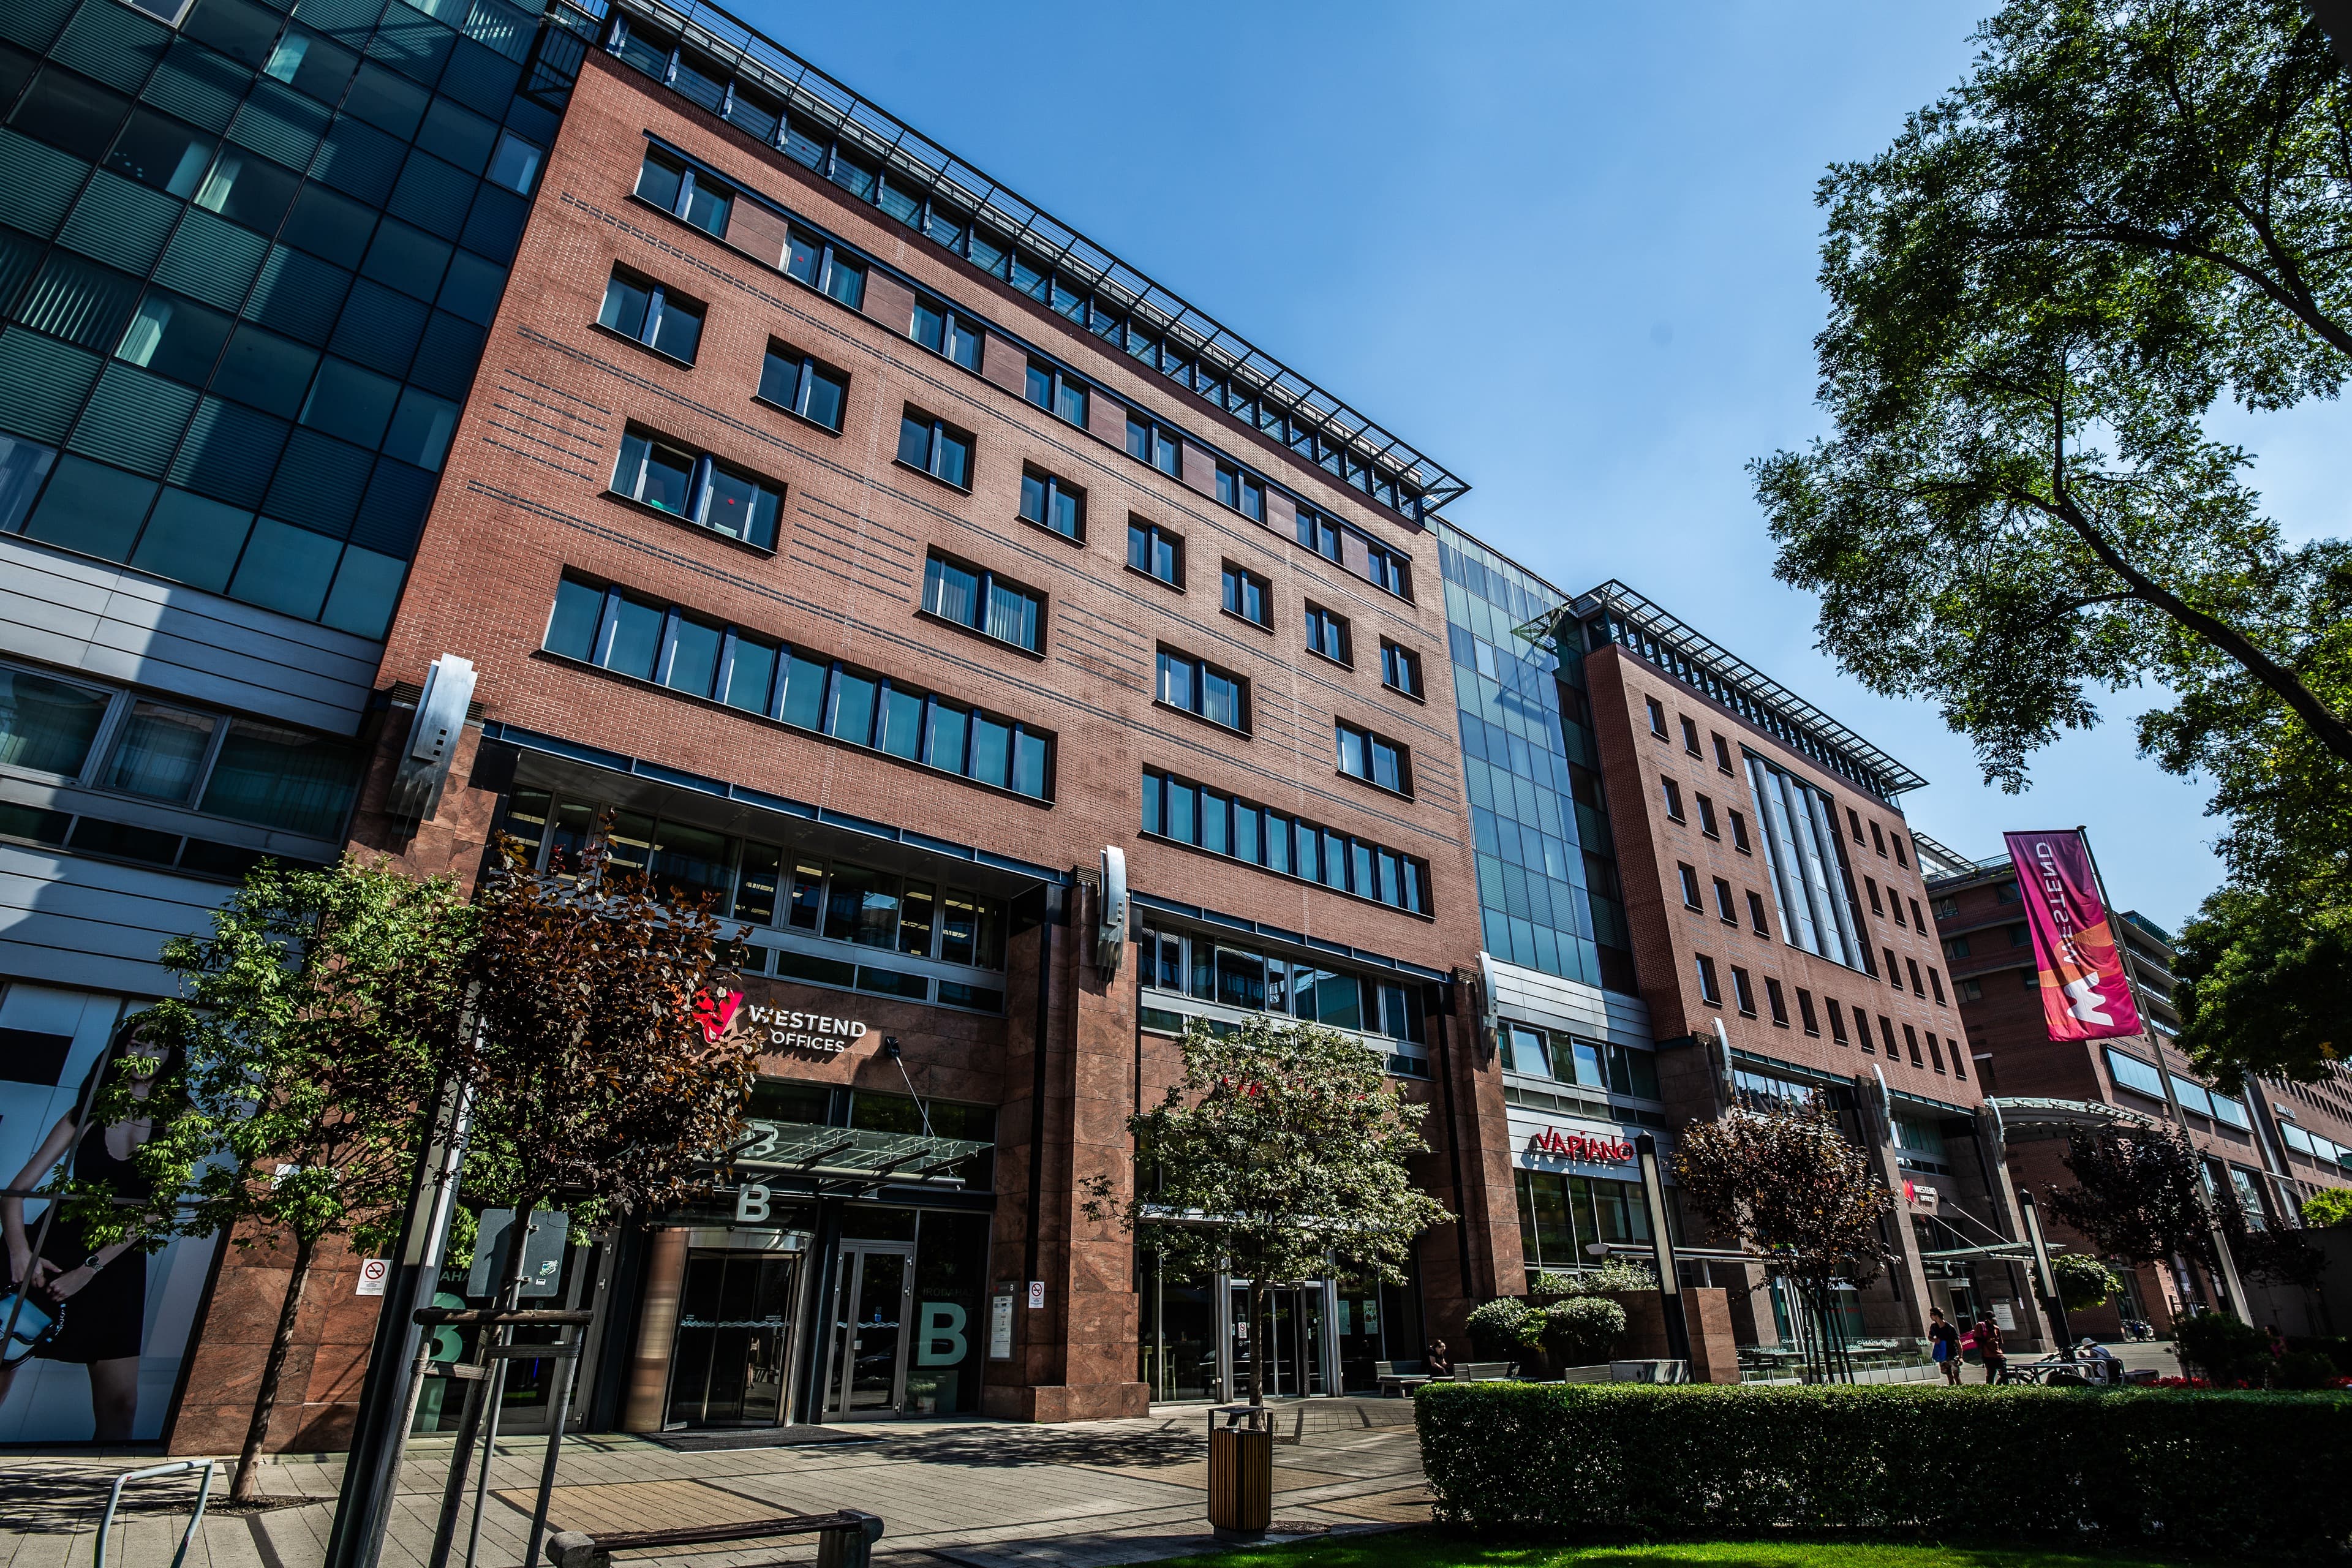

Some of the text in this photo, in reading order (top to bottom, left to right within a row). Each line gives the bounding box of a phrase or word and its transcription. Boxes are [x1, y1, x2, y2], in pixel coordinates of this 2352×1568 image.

[748, 1005, 867, 1038] WESTEND
[771, 1031, 845, 1053] OFFICES
[736, 1183, 771, 1223] B
[1913, 1185, 1936, 1195] WESTEND
[1943, 1260, 1953, 1276] C
[916, 1302, 968, 1366] B
